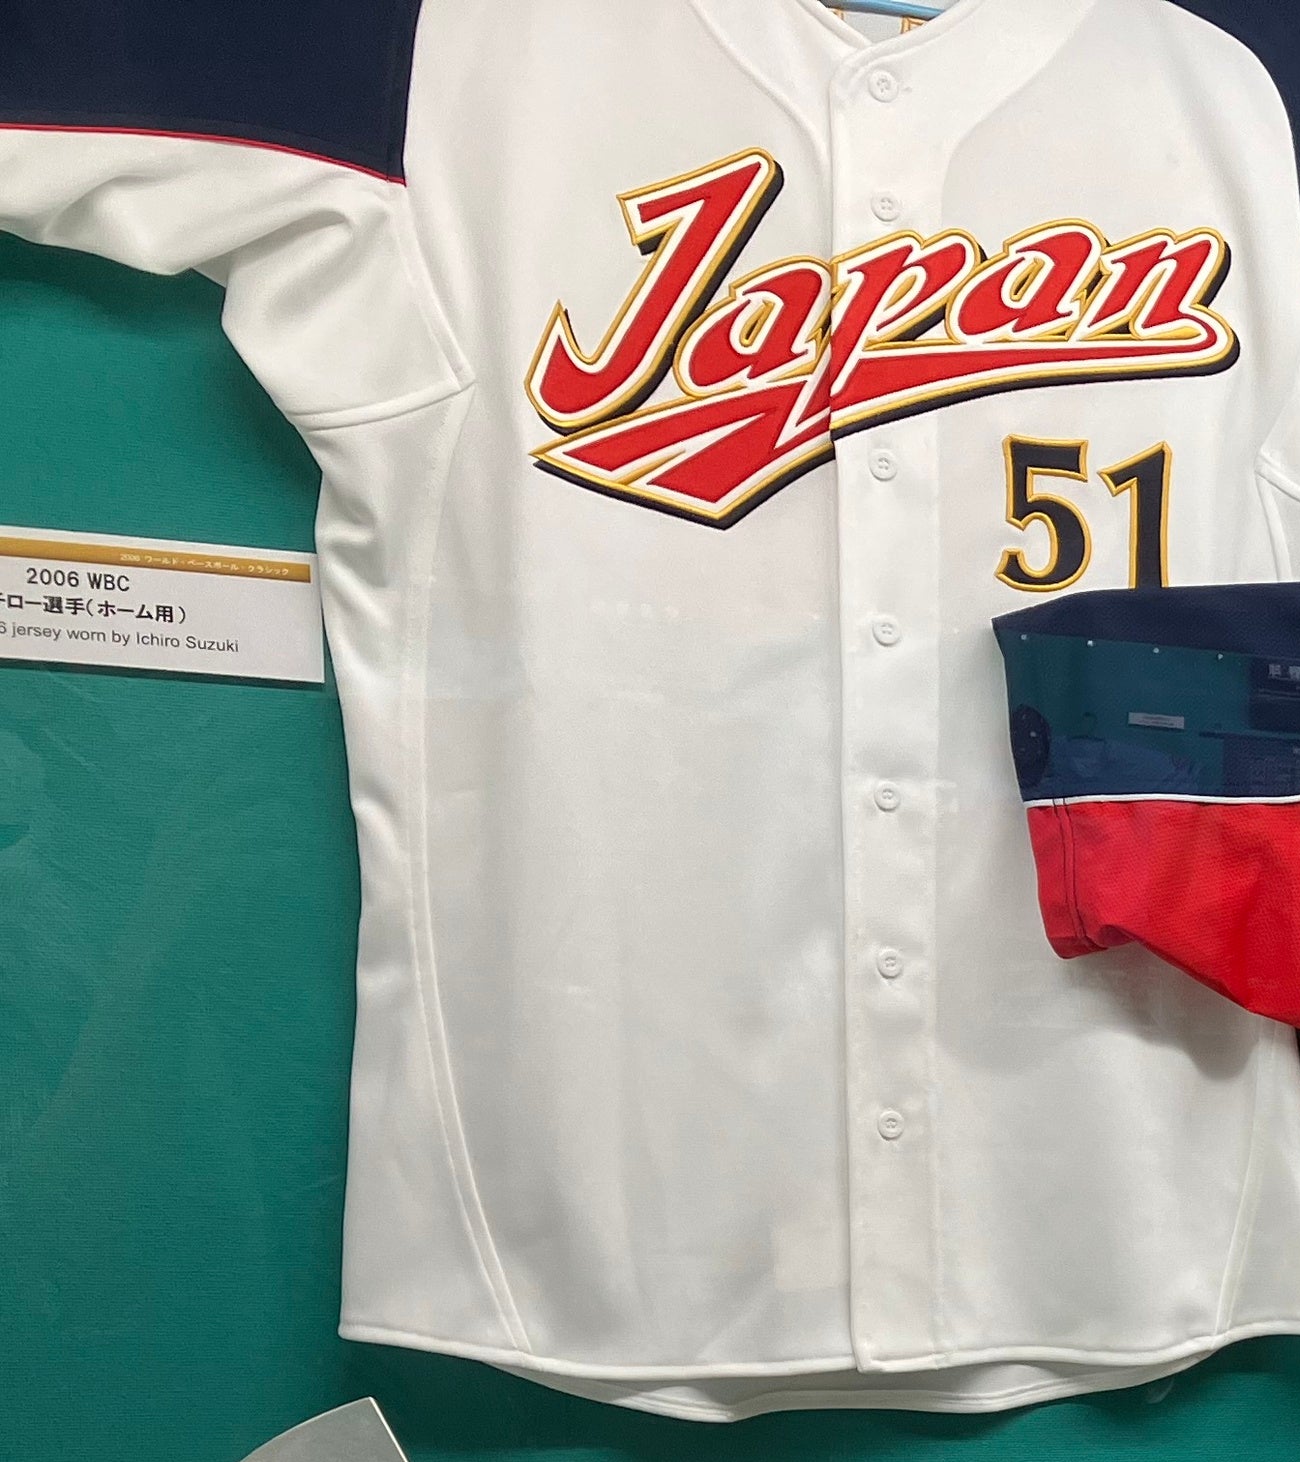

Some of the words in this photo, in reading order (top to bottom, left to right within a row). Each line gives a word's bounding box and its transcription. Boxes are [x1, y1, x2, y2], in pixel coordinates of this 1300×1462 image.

[524, 147, 1241, 530] Japan
[993, 434, 1173, 592] 51
[26, 567, 80, 588] 2006
[87, 572, 130, 592] WBC
[12, 624, 62, 641] jersey
[66, 630, 106, 642] worn
[111, 629, 131, 647] by
[136, 631, 180, 649] Ichiro
[185, 635, 240, 653] Suzuki
